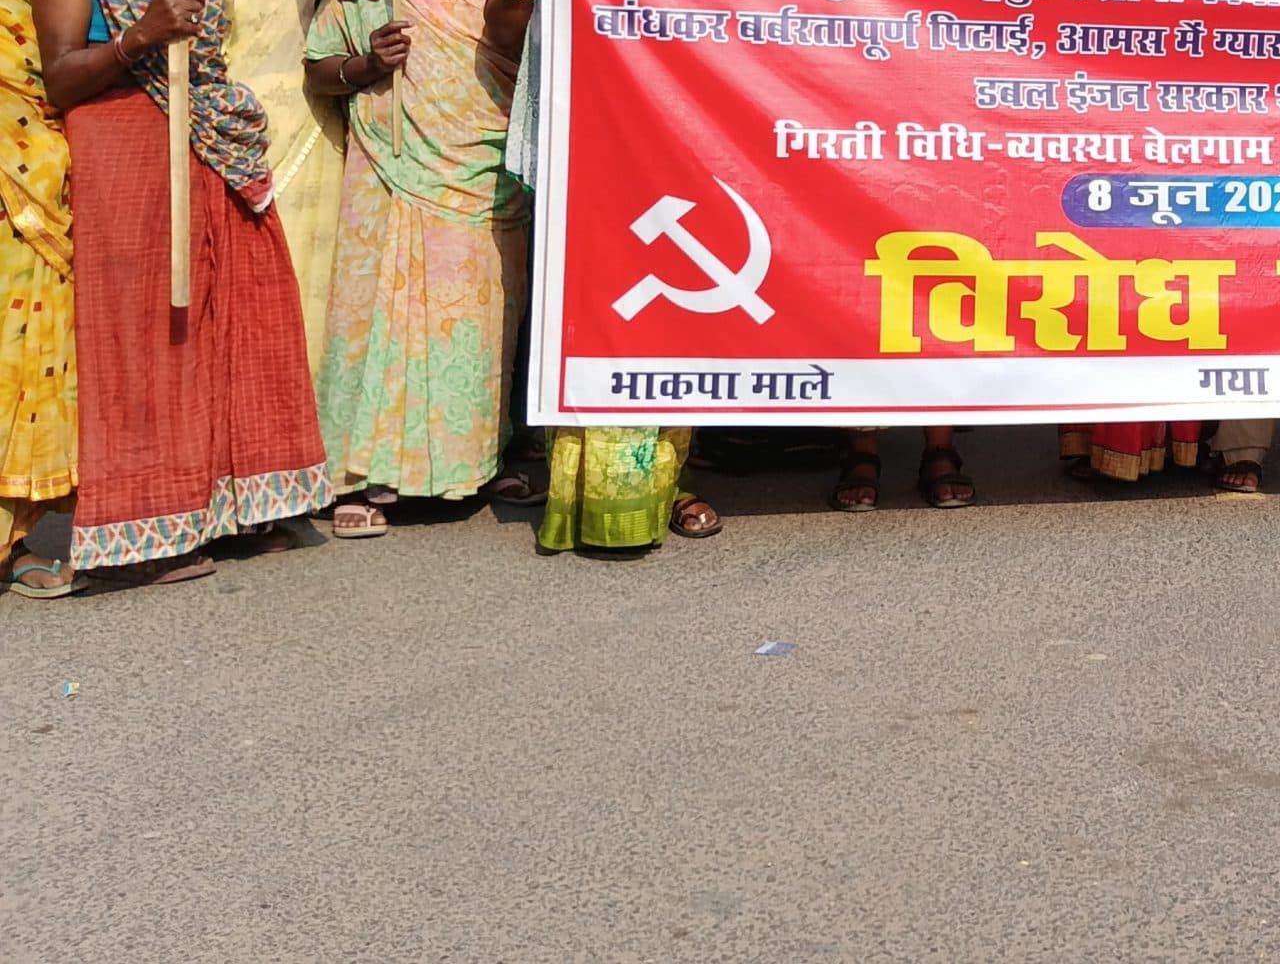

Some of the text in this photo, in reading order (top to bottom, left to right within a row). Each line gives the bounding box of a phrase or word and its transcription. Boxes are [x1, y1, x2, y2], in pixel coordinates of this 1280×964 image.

[736, 4, 920, 60] बर्बरतापूर्ण
[926, 12, 1046, 59] पिटाई,
[1056, 22, 1168, 56] आमस
[1174, 20, 1206, 56] में
[974, 76, 1060, 110] डबल
[1064, 70, 1151, 114] इंजन
[1156, 81, 1270, 114] सरकार
[773, 118, 887, 161] गिरती
[894, 121, 1135, 164] विधि-व्यवस्था
[1142, 126, 1275, 165] बेलगाम
[1086, 179, 1112, 212] 8
[1127, 180, 1215, 225] जून
[863, 230, 1237, 354] विरोध
[610, 363, 835, 401] भाकपा माले
[1197, 366, 1270, 396] गया
